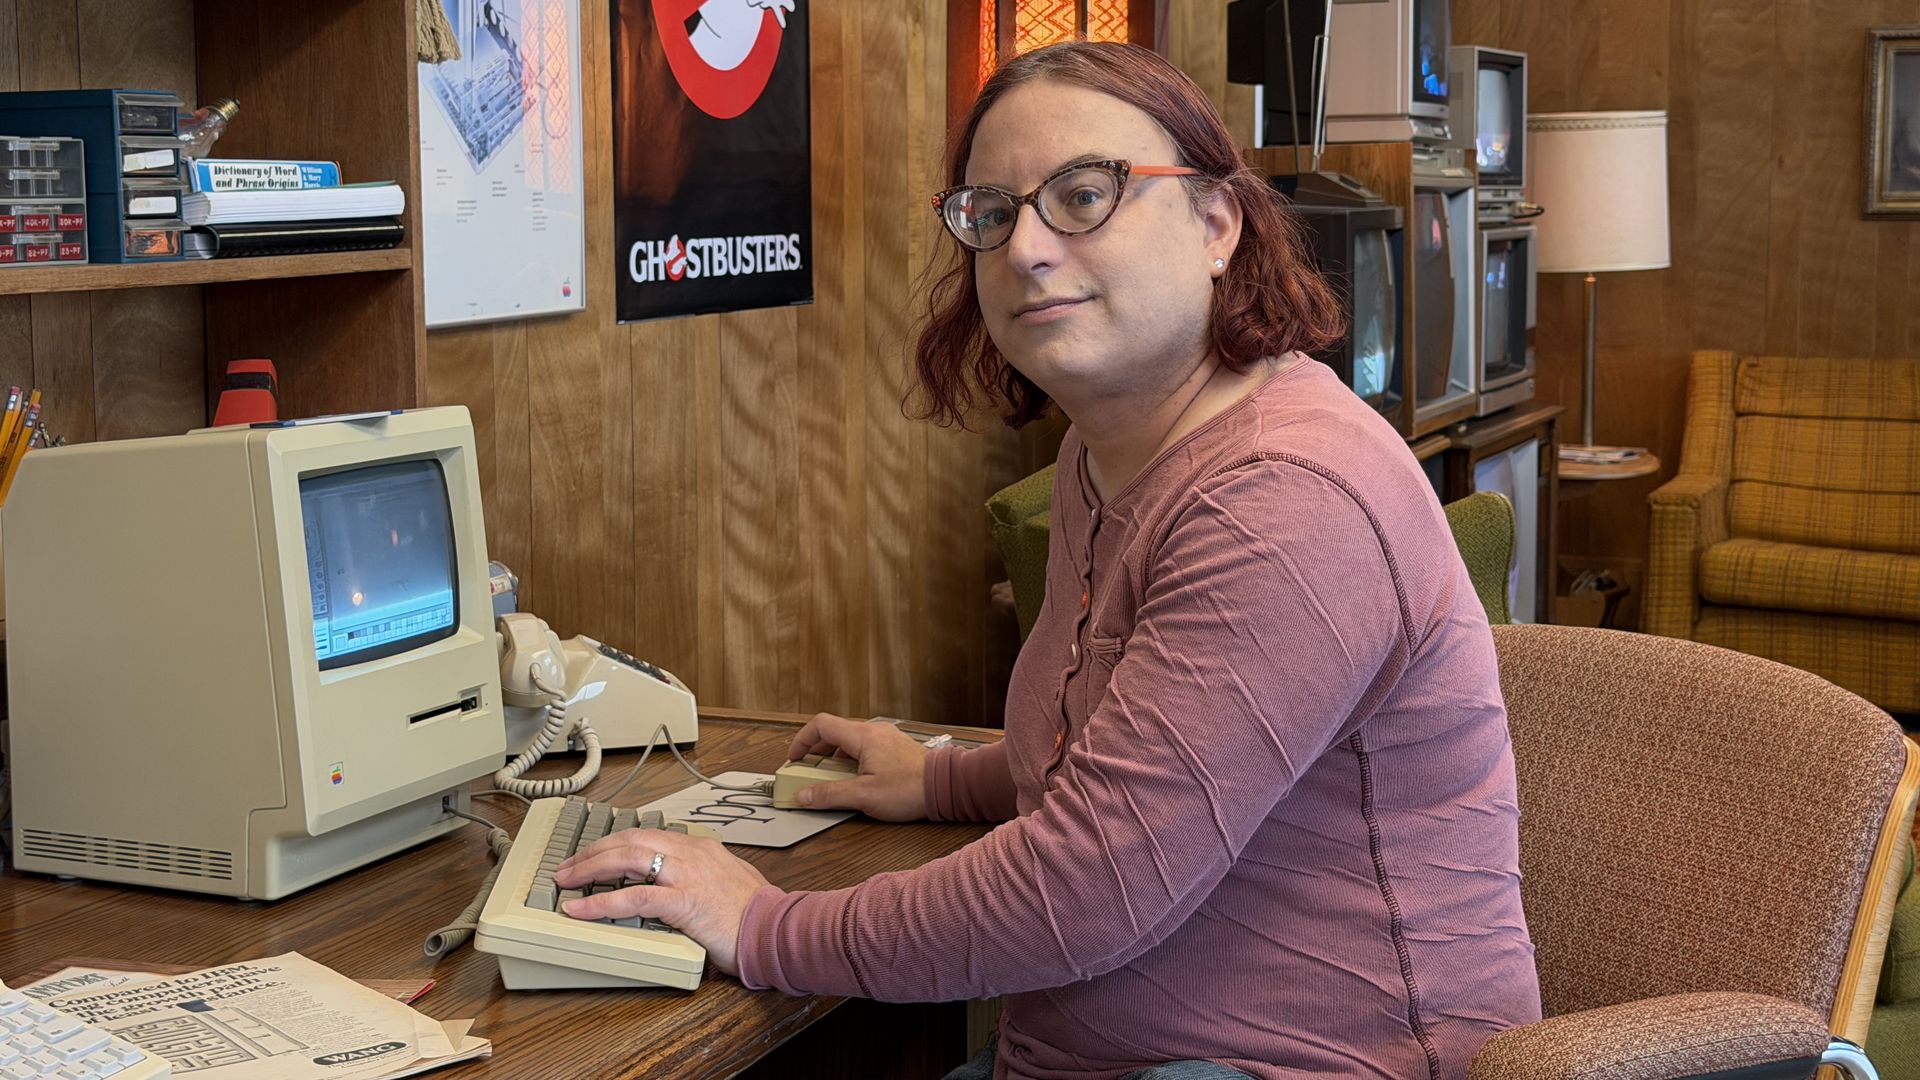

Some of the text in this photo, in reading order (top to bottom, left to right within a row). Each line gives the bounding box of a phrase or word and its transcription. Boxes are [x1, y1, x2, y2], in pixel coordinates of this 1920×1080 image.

[214, 165, 297, 178] Dictionary of Word
[216, 178, 299, 189] and Phrase Origins
[629, 234, 801, 283] GHOSTBUSTERS
[48, 981, 172, 1008] Compared
[174, 974, 199, 985] to
[200, 965, 258, 979] IBM,
[59, 1002, 104, 1014] ang
[106, 978, 227, 1006] computers
[228, 966, 282, 980] have
[77, 978, 262, 1018] the growth path
[102, 1006, 160, 1021] least
[322, 1043, 397, 1063] WANG
